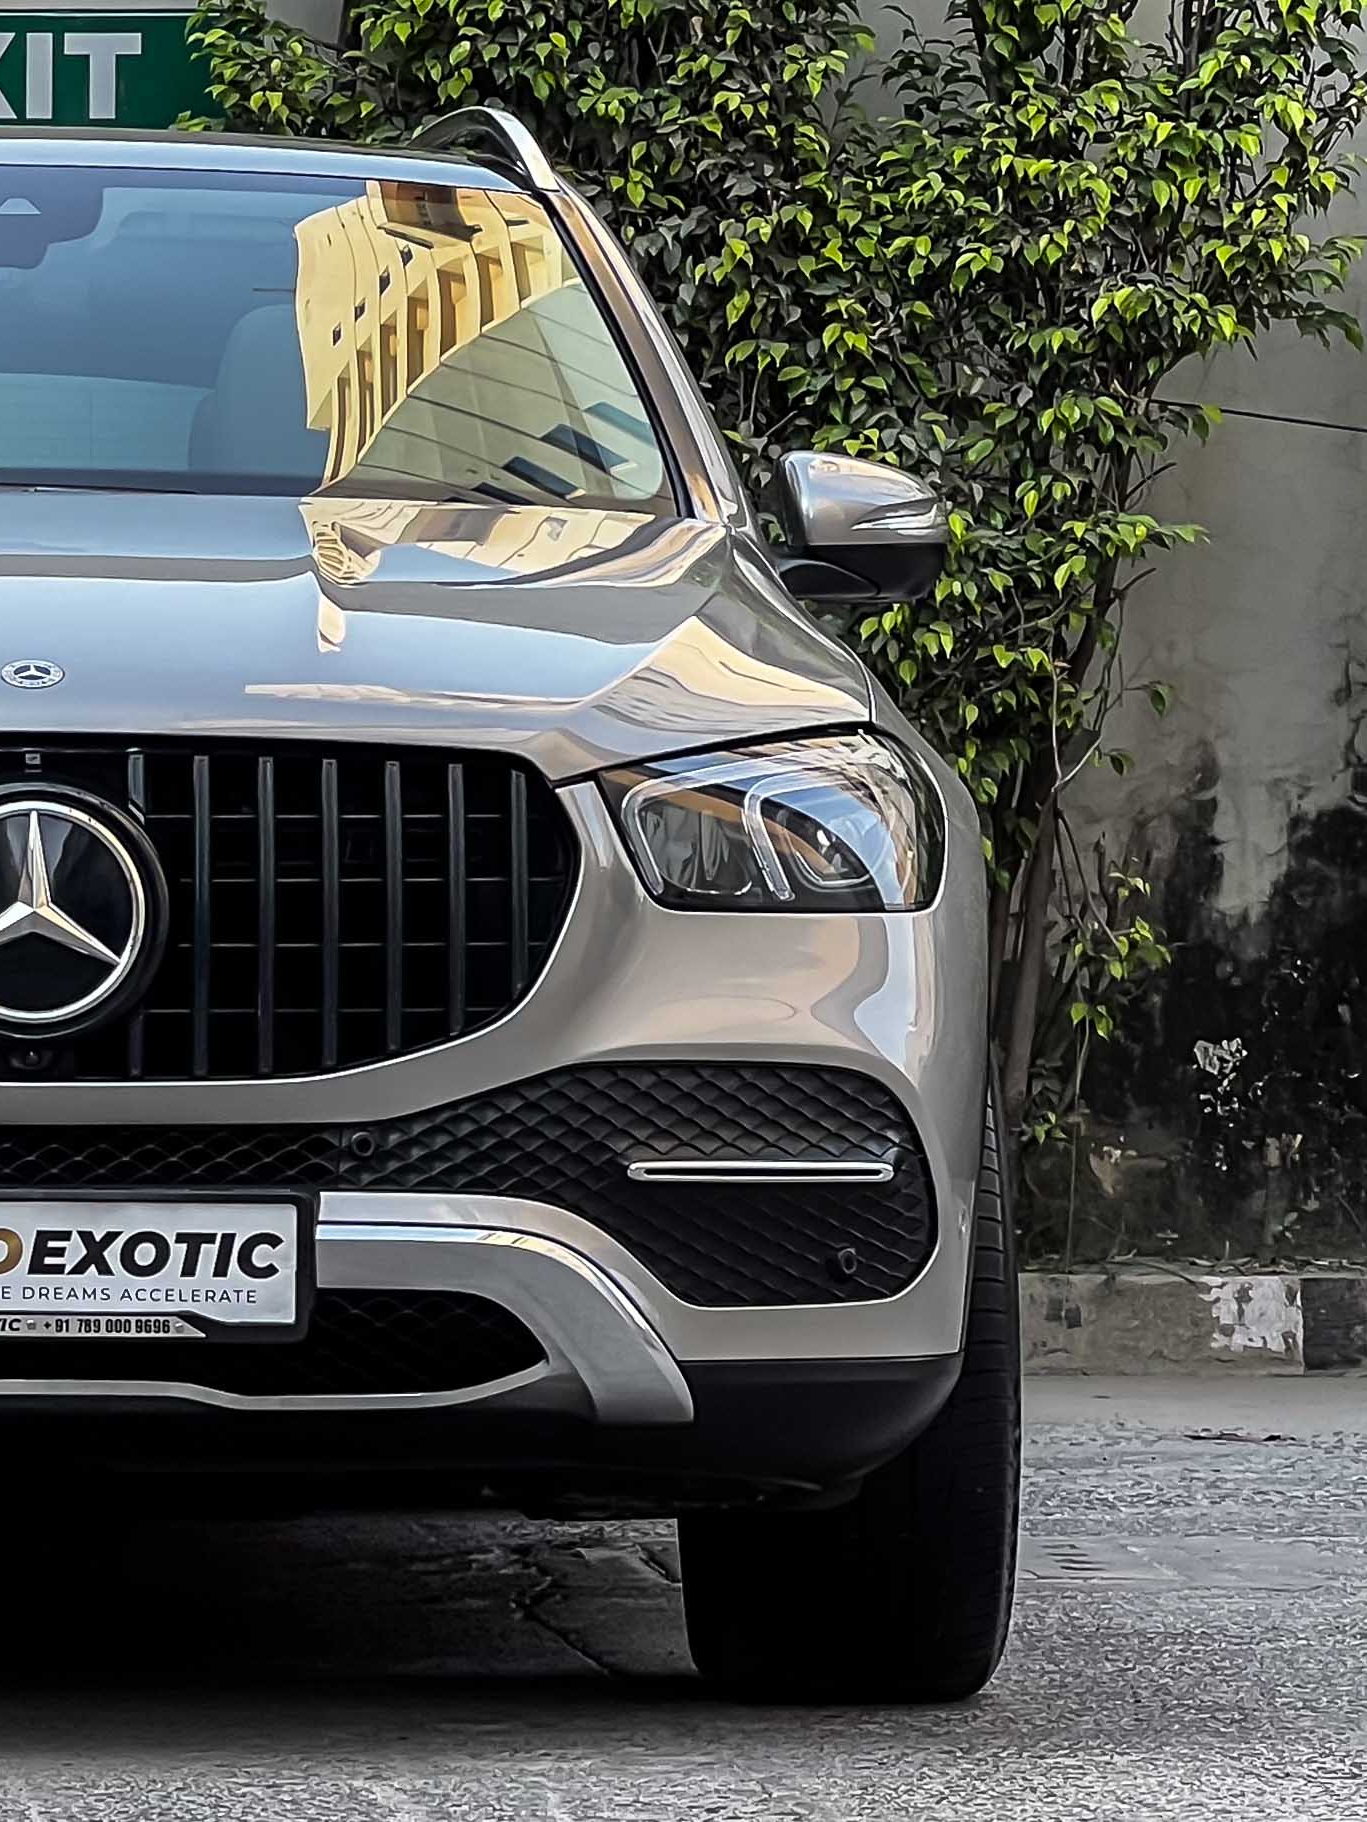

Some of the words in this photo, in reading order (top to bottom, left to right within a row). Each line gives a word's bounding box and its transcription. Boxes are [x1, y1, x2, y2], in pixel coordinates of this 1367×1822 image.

[22, 1287, 110, 1302] DREAMS
[120, 1288, 256, 1303] ACCELERATE
[76, 1319, 101, 1334] 789
[104, 1319, 132, 1334] 000
[135, 1320, 171, 1334] 9696
